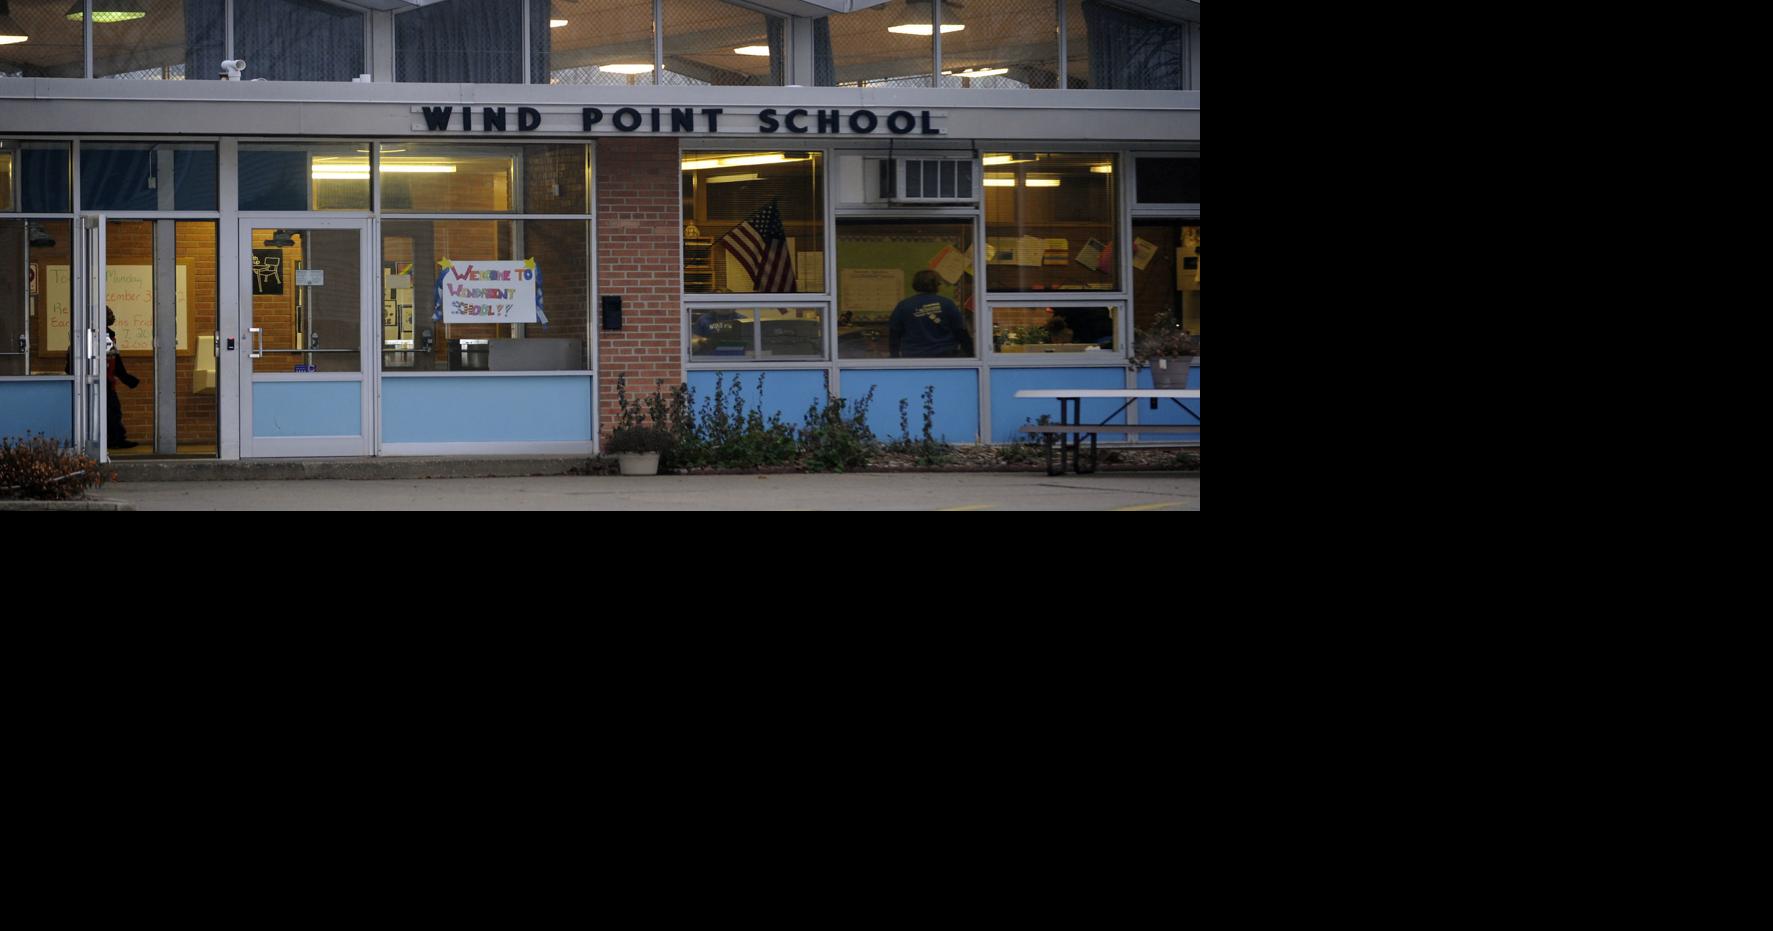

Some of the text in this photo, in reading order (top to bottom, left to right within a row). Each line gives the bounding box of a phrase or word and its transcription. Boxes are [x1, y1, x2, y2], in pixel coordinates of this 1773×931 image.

[422, 106, 940, 135] WIND POINT SCHOOL
[514, 268, 533, 281] TO
